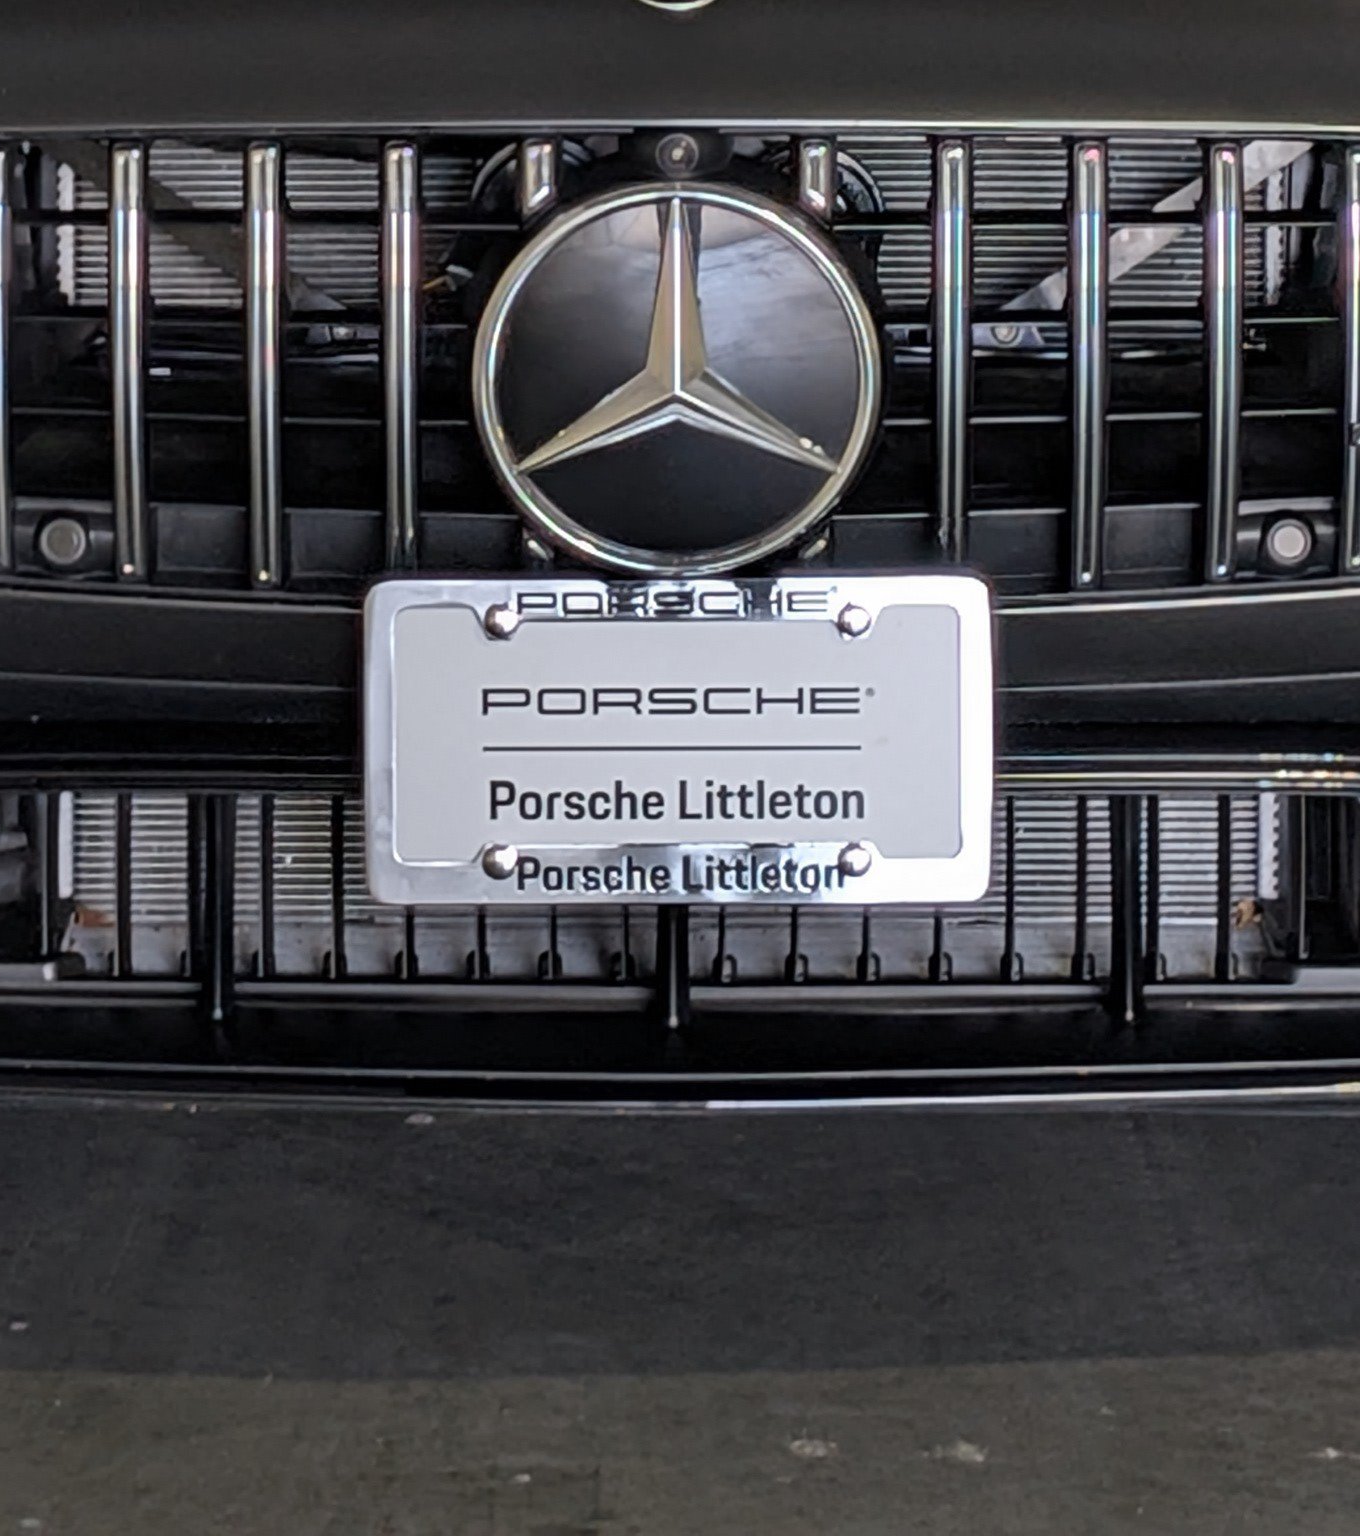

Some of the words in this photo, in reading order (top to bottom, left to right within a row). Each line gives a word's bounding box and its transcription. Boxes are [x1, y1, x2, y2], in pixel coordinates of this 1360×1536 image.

[515, 590, 829, 616] PORSCHE
[481, 686, 861, 716] PORSCHE
[488, 779, 665, 821] Porsche
[678, 779, 866, 820] Littleton
[516, 855, 671, 892] Porsche
[681, 855, 846, 892] Littleton
